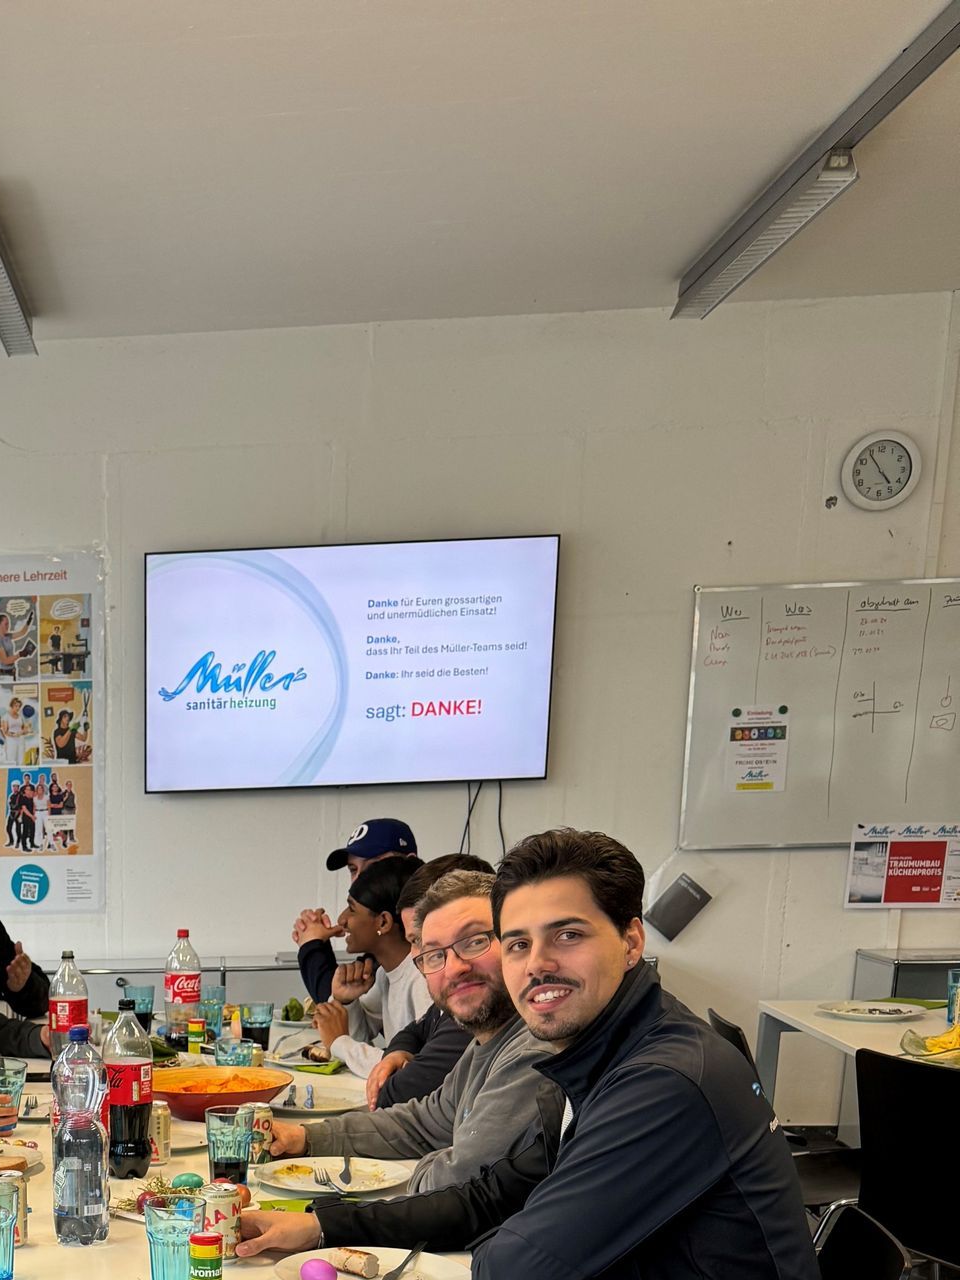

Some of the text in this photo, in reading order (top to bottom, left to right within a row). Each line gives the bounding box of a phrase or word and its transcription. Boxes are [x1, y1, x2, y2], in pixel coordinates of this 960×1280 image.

[877, 445, 887, 454] 12
[859, 458, 868, 466] 10
[896, 454, 903, 463] 2
[855, 469, 861, 477] 9
[900, 466, 906, 474] 3
[857, 478, 864, 487] 8
[895, 477, 902, 485] 4
[865, 486, 871, 496] 7
[875, 489, 882, 497] 6
[887, 485, 893, 495] 5
[23, 570, 68, 582] Lehrzeit
[367, 595, 502, 608] Danke für Euren grossartigen
[785, 602, 812, 614] Was
[367, 607, 497, 620] und unermüdlichen Einsatz!
[366, 635, 400, 645] Danke,
[366, 641, 528, 656] dass Ihr Teil des Müller-Teams seid!
[365, 667, 489, 680] Danke: Ihr seid die Besten!
[186, 697, 277, 711] sanitärheizung
[365, 699, 482, 722] sagt: DANKE!
[863, 825, 895, 837] Müller
[898, 825, 930, 836] Müller
[889, 859, 941, 868] TRAUMUMBAU
[888, 867, 942, 876] KÜCHENPROFIS
